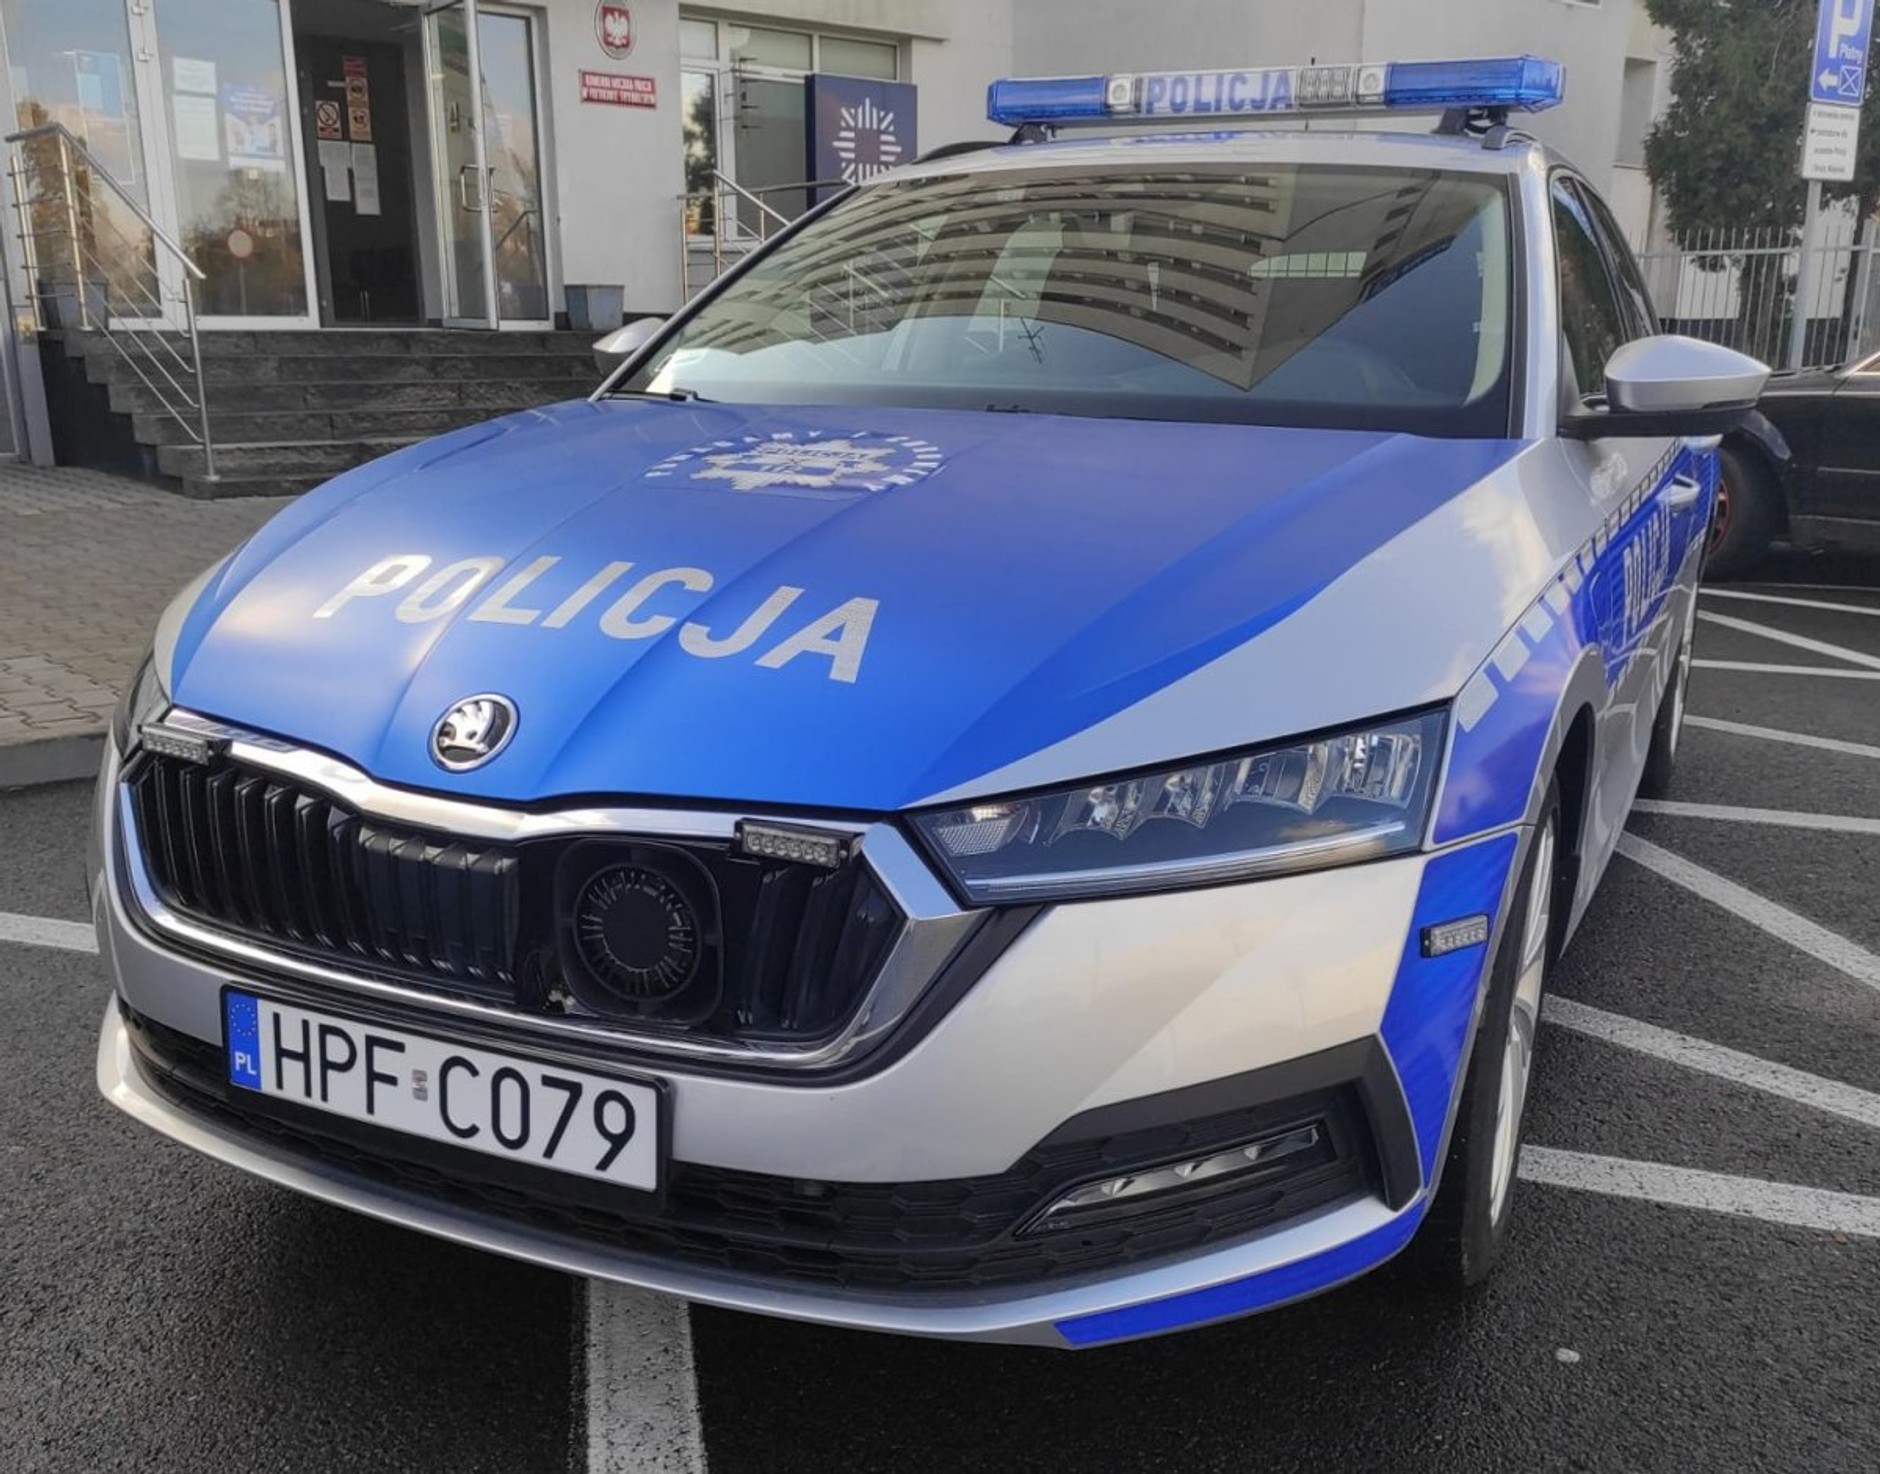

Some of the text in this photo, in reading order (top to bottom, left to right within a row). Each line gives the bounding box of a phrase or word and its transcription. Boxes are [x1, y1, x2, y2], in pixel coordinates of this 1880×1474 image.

[1828, 0, 1864, 59] P
[1145, 70, 1294, 115] POLICJA
[313, 554, 880, 684] POLICJA
[234, 1051, 257, 1076] PL
[272, 1011, 637, 1172] HPF C079
